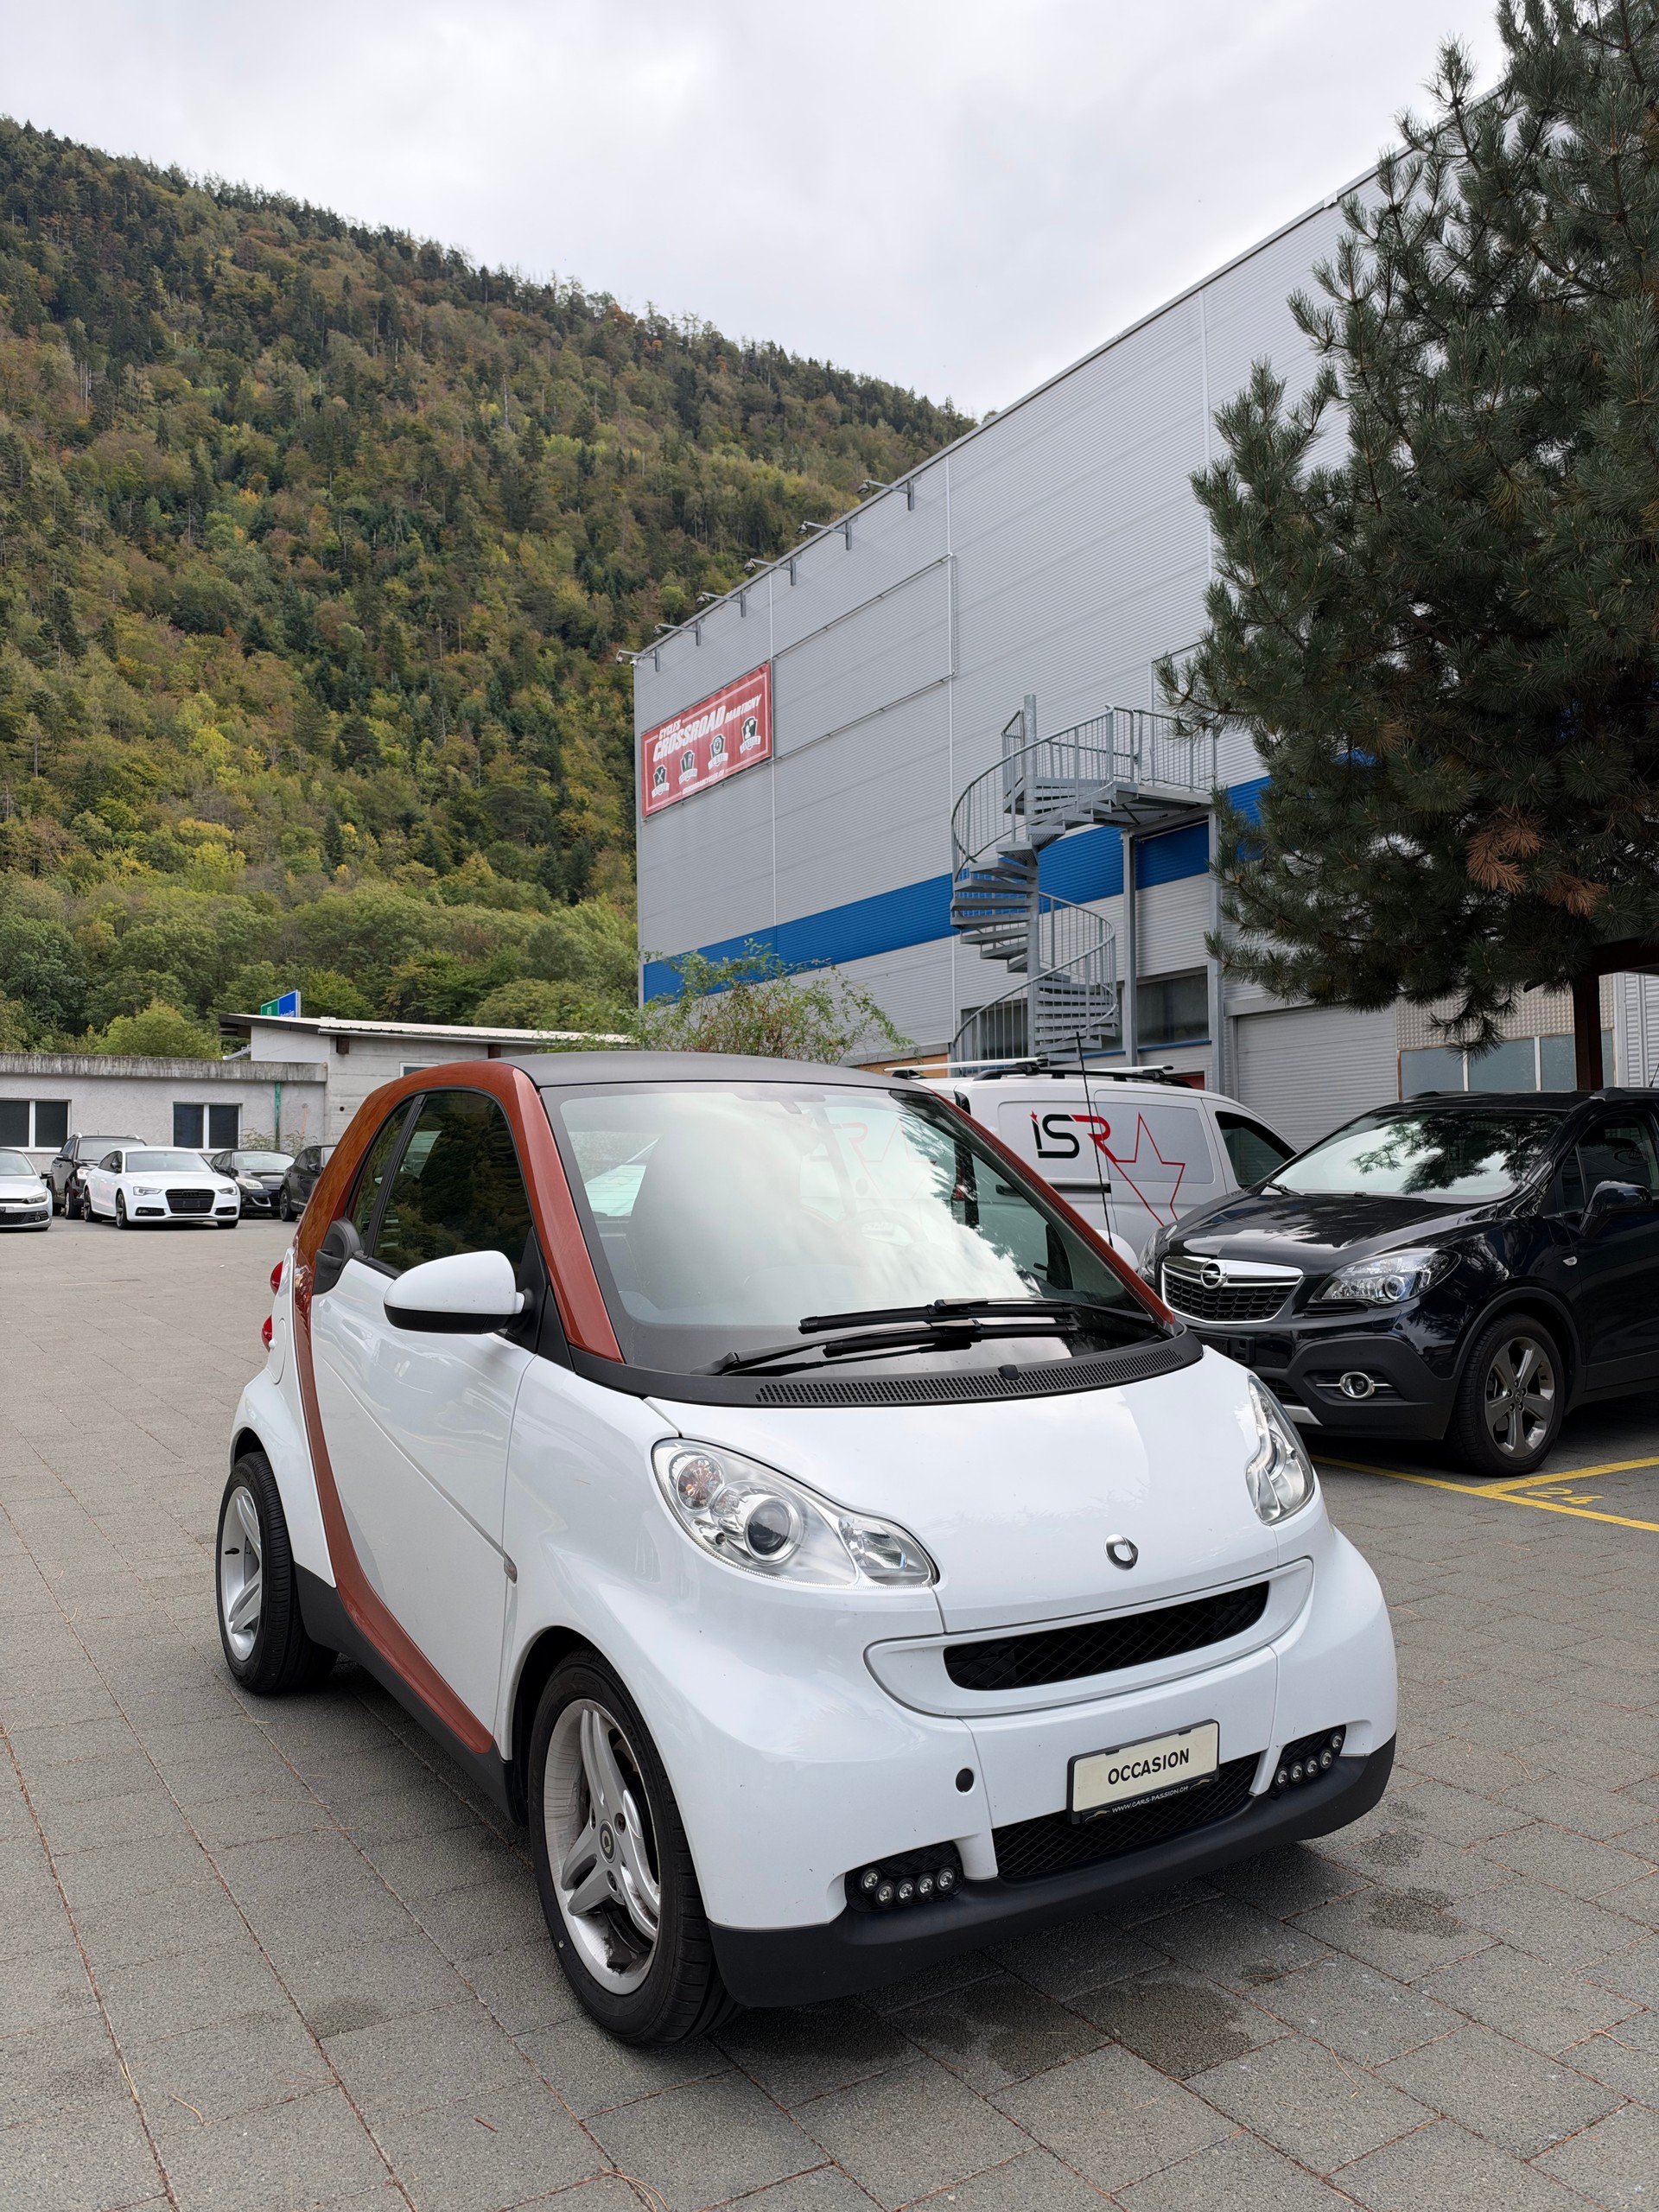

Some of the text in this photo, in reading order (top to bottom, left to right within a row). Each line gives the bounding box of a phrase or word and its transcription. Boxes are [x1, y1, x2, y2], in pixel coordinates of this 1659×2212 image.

[653, 705, 727, 762] CROSSROAD
[658, 719, 682, 741] CYCLES
[1108, 1748, 1189, 1785] OCCASION
[1112, 1785, 1189, 1814] WWW.CARS-PASSION.CH
